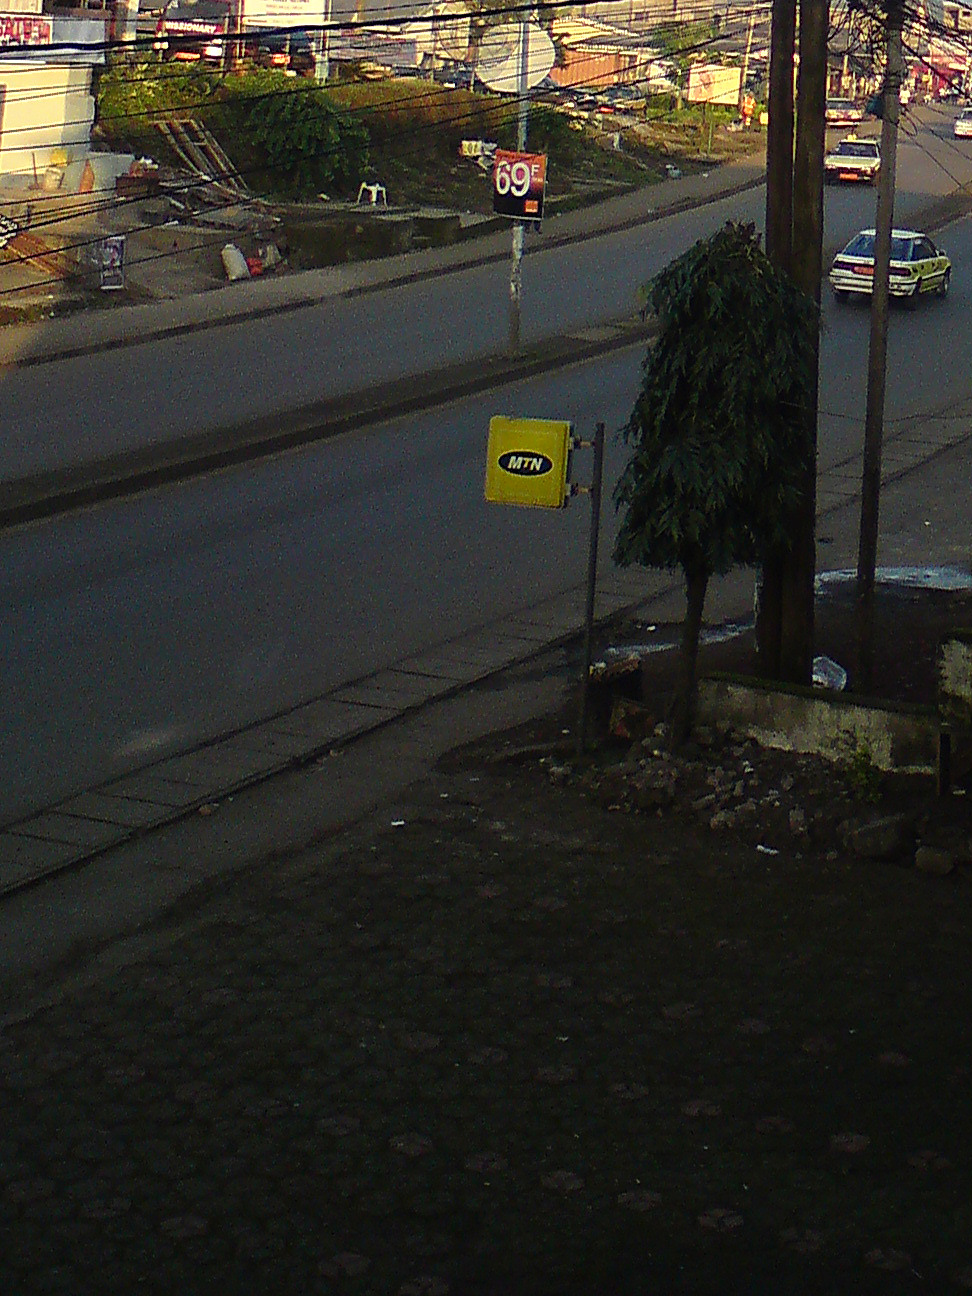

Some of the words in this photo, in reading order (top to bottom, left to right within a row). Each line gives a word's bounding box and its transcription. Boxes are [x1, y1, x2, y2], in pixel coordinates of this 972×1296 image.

[496, 160, 530, 196] 69
[531, 164, 540, 176] F
[507, 455, 543, 471] MTN
